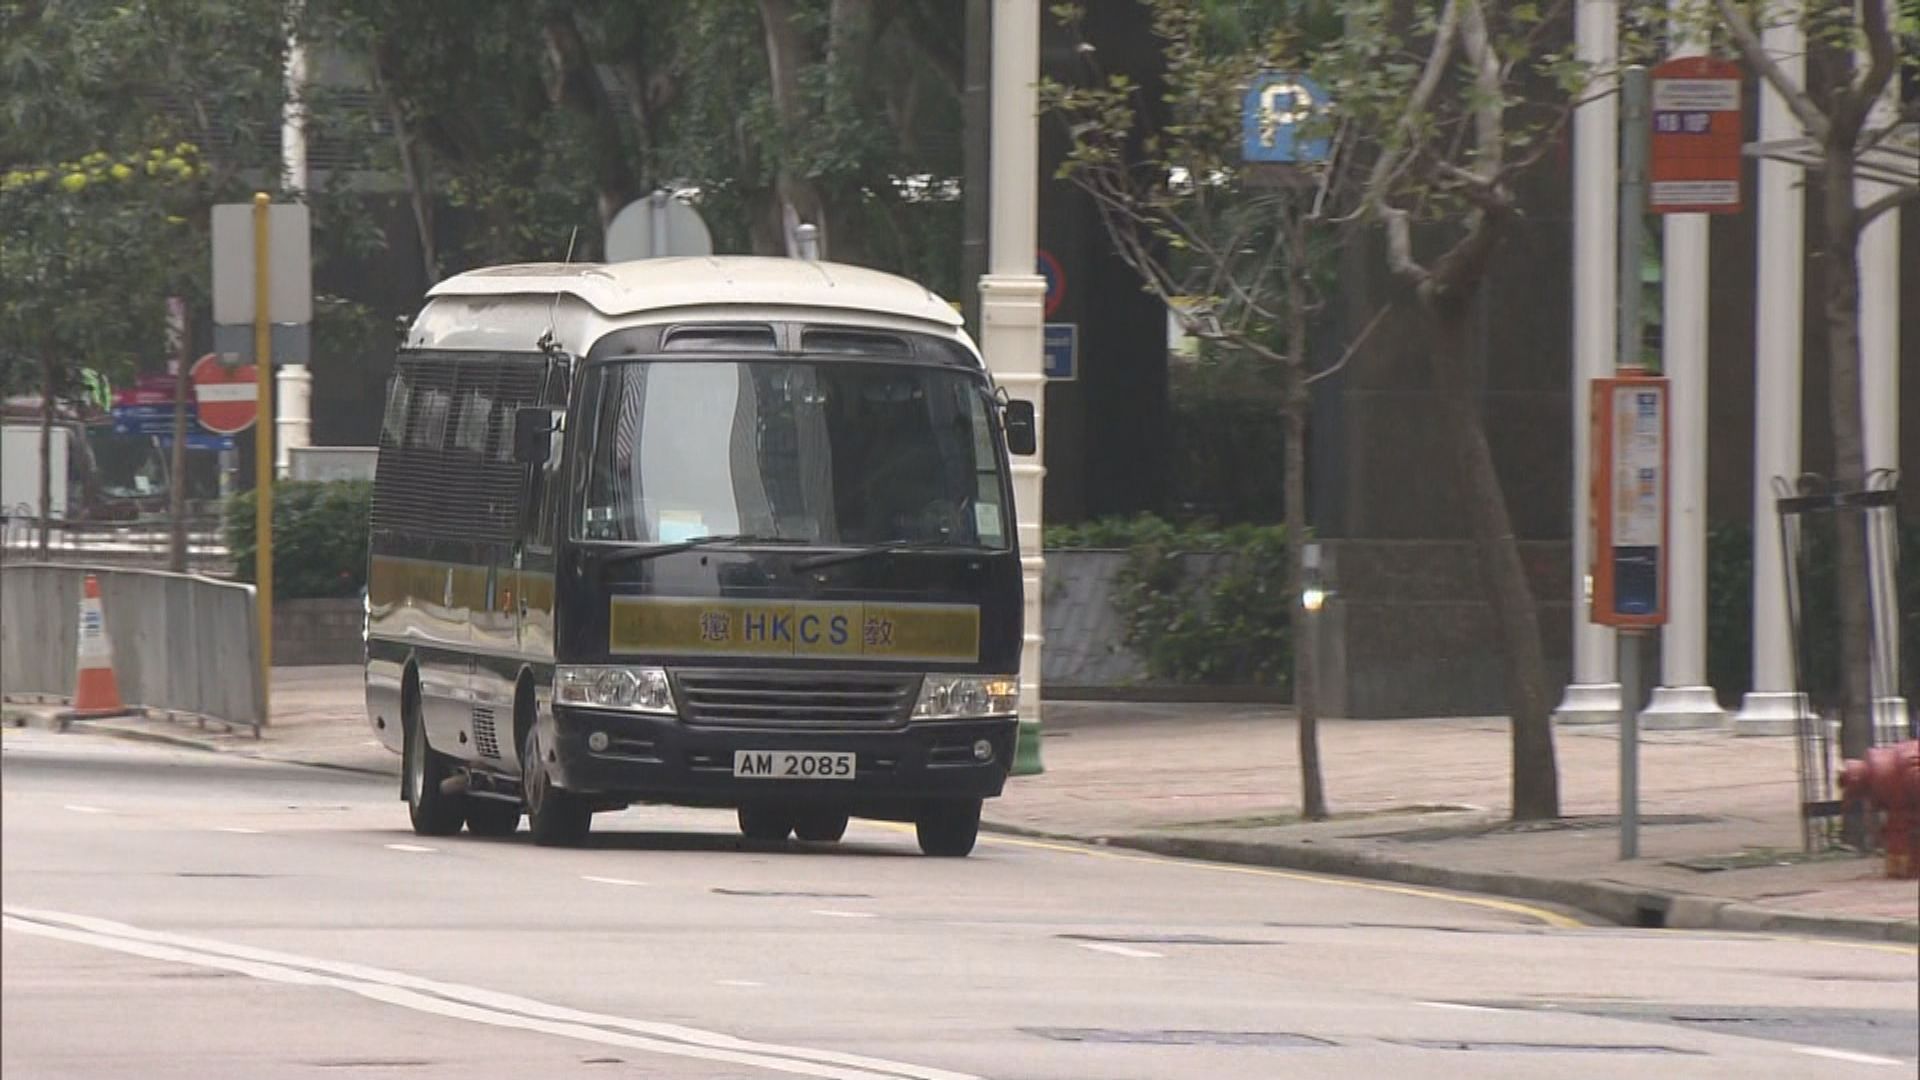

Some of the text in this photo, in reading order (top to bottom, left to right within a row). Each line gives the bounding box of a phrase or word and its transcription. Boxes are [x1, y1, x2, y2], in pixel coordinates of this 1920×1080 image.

[1260, 83, 1312, 147] P
[746, 613, 849, 645] HKCS
[739, 753, 851, 776] AM 2085
